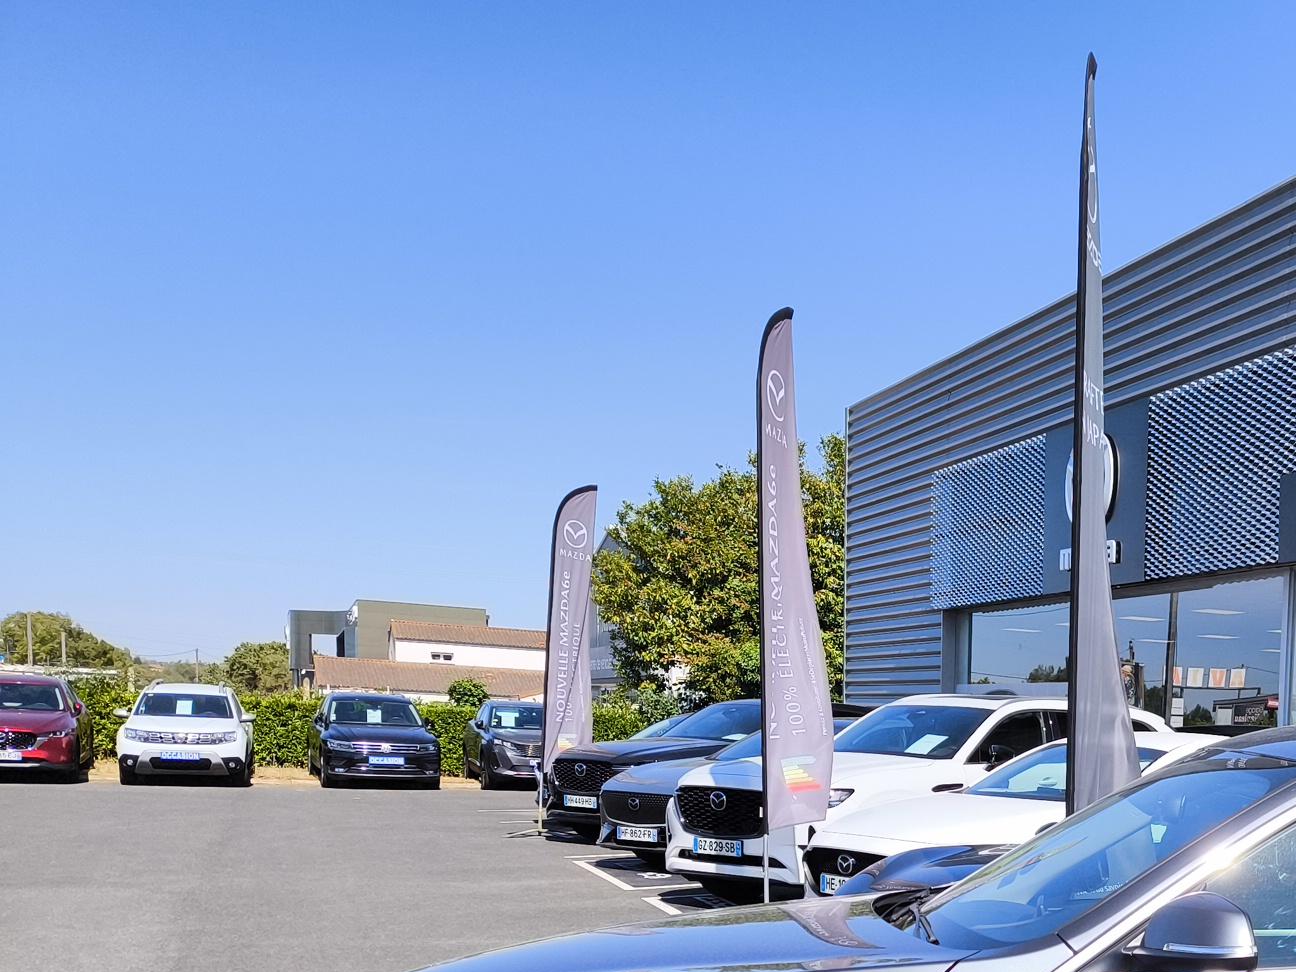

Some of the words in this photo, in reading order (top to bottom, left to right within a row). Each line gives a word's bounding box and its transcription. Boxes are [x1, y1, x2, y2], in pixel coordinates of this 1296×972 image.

[560, 549, 593, 562] MAZDA
[559, 571, 571, 648] MAZDA6e
[555, 649, 569, 722] NOUVELLE
[161, 751, 200, 761] OCCASION
[369, 756, 404, 765] OCCASION
